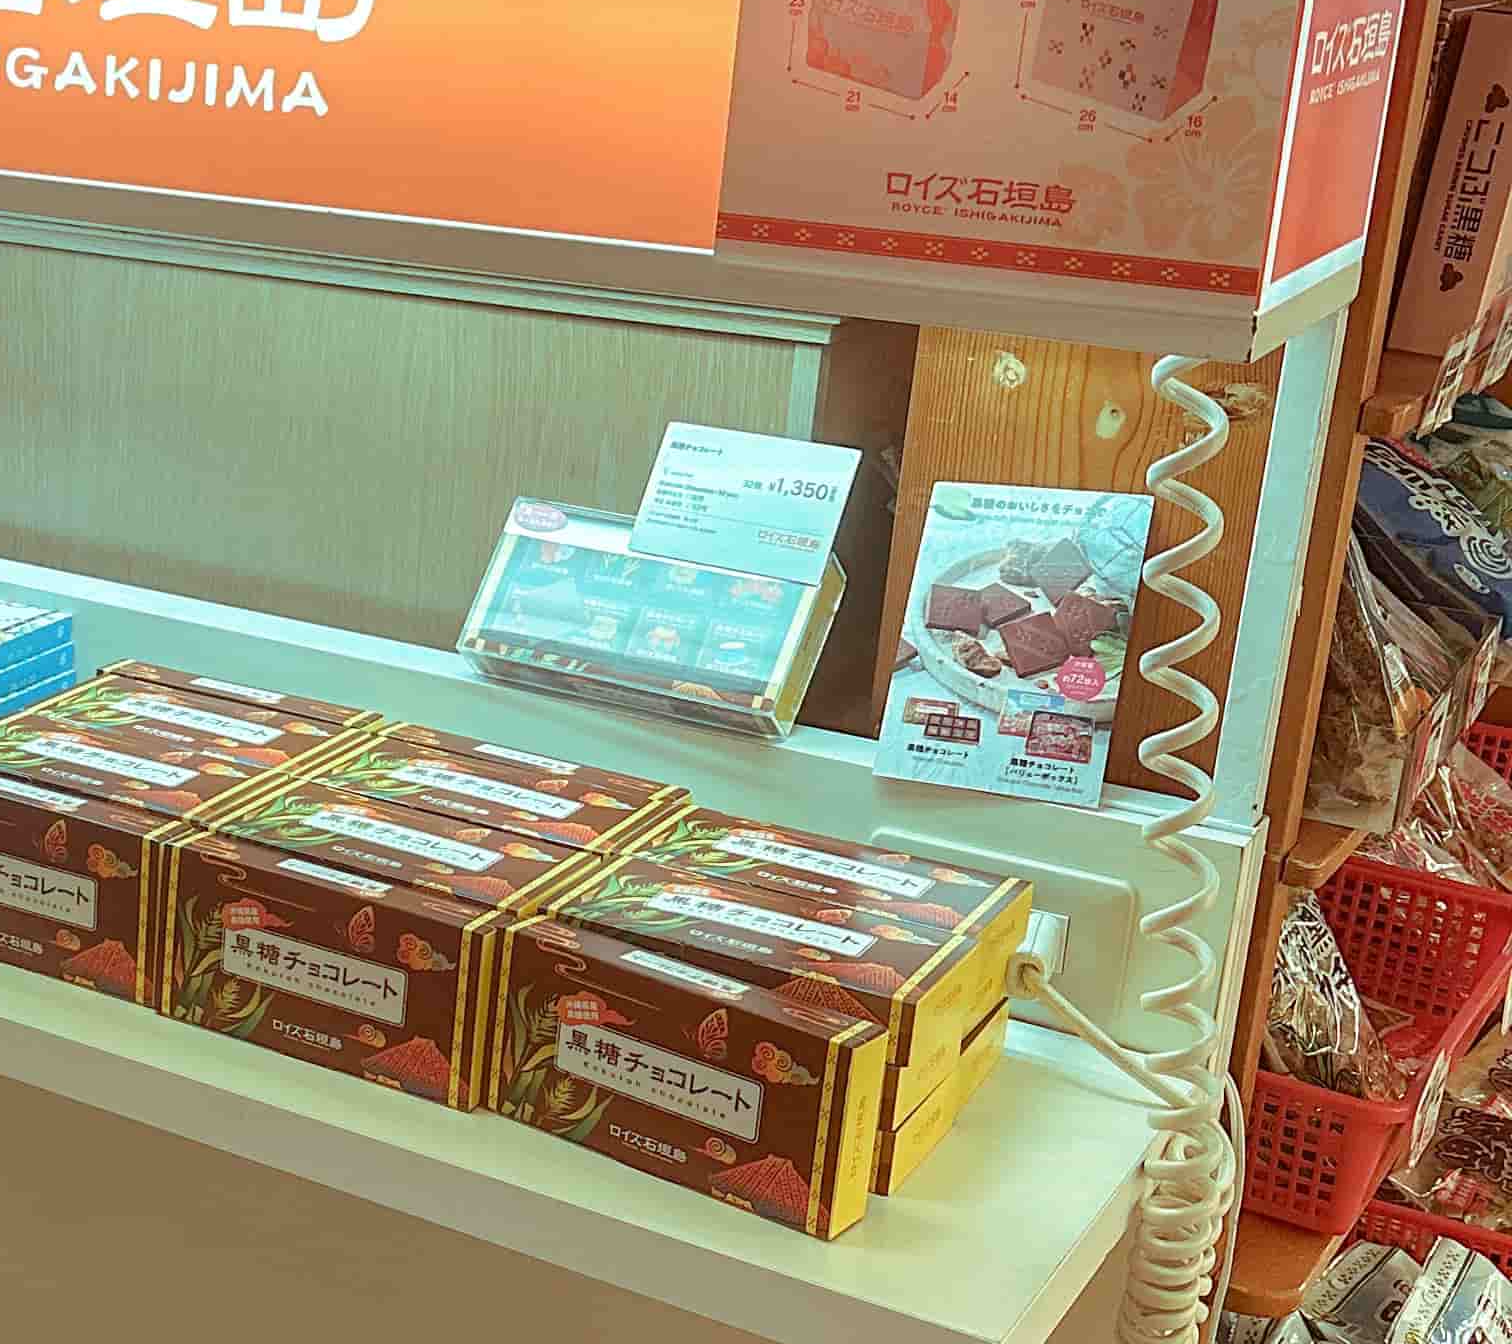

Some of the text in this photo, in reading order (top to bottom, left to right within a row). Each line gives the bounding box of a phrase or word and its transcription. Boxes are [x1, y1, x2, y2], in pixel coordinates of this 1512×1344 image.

[1311, 9, 1393, 76] ロイズ石垣島
[846, 90, 862, 103] 21
[943, 92, 958, 104] 14
[1080, 110, 1096, 122] 26
[1187, 115, 1203, 128] 16
[887, 171, 1076, 213] ロイズ石垣島
[953, 207, 1063, 228] ISHIGAKIJIMA
[229, 933, 399, 1001] 黒糖チョコレート
[272, 1019, 344, 1051] ロイズ石垣島
[565, 1029, 751, 1112] 黒糖チョコレート
[609, 1123, 687, 1162] ロイズ石垣島
